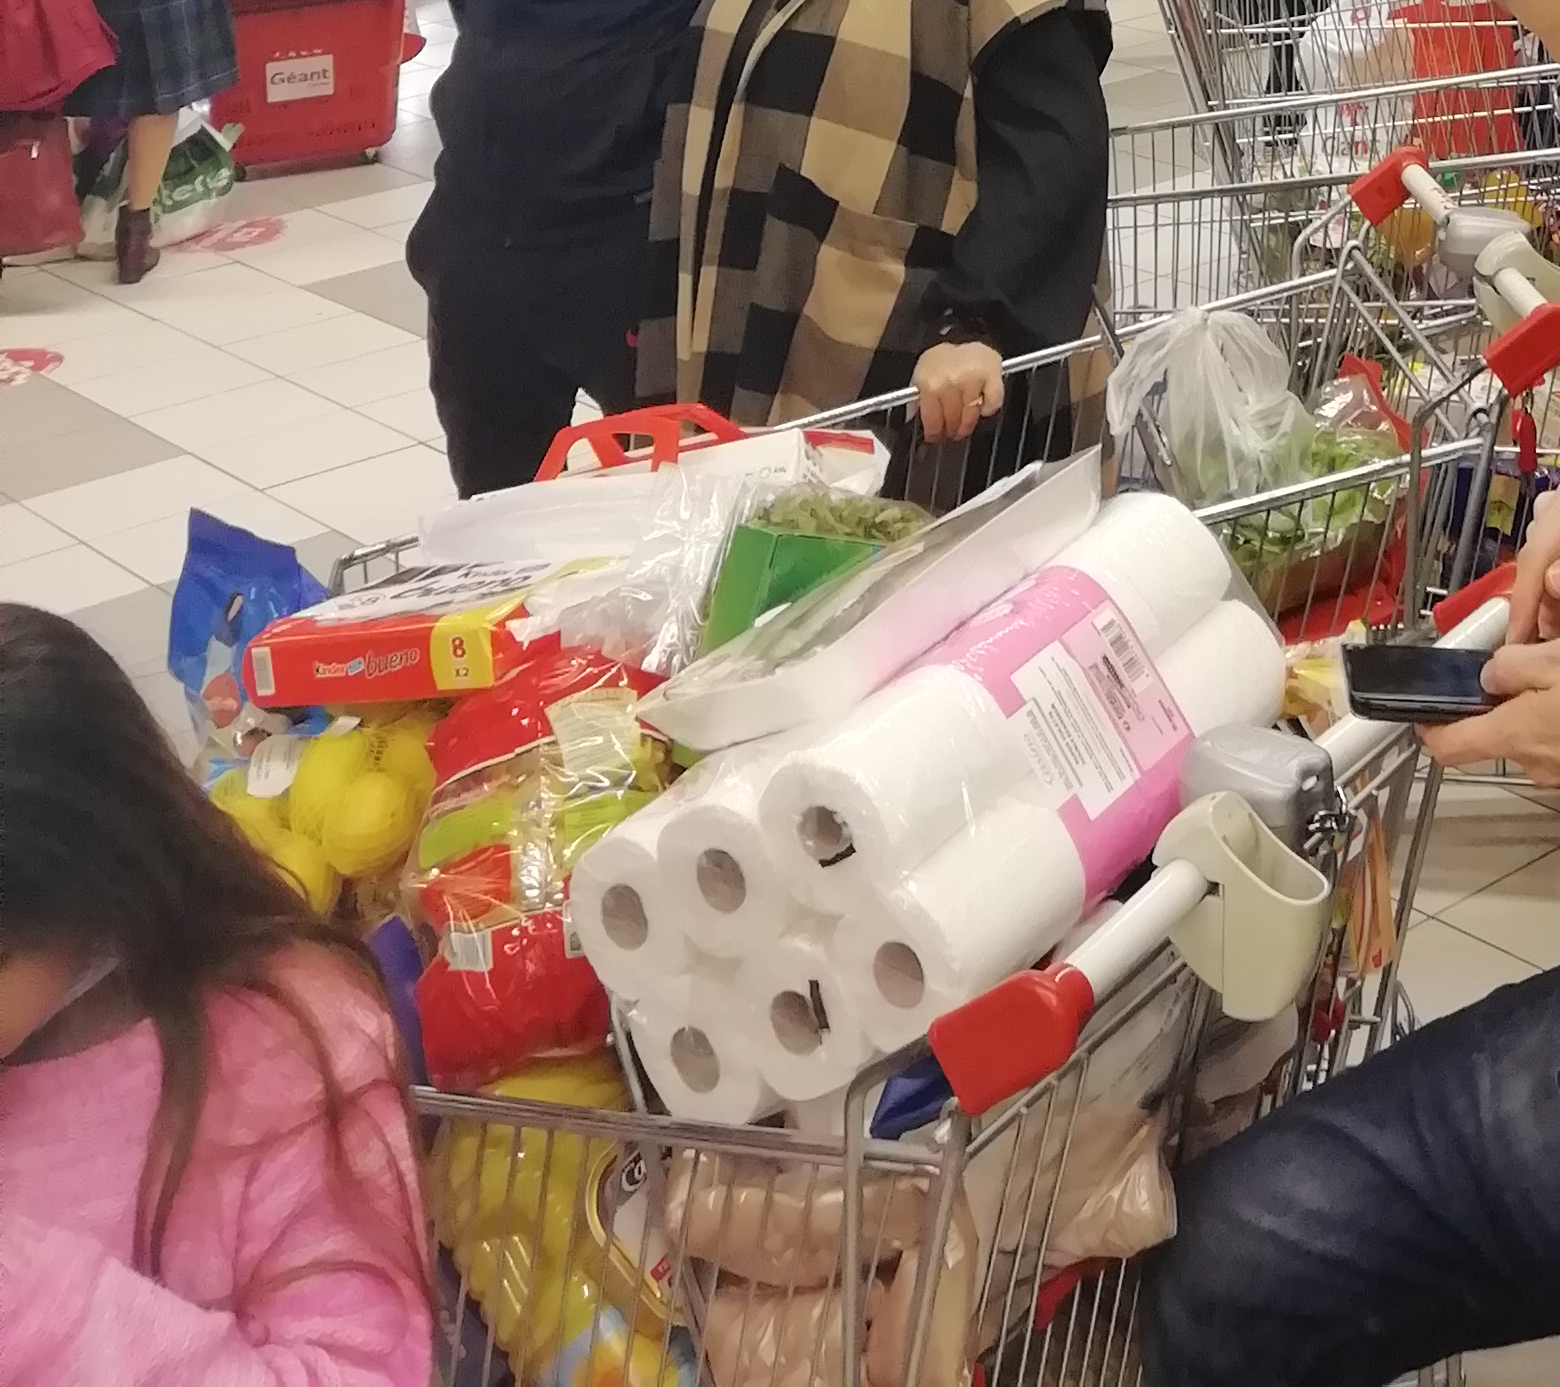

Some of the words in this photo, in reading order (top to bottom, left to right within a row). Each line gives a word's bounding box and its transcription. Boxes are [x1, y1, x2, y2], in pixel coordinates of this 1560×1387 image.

[270, 68, 329, 85] Géant
[452, 636, 466, 658] 8
[366, 649, 418, 678] bueno
